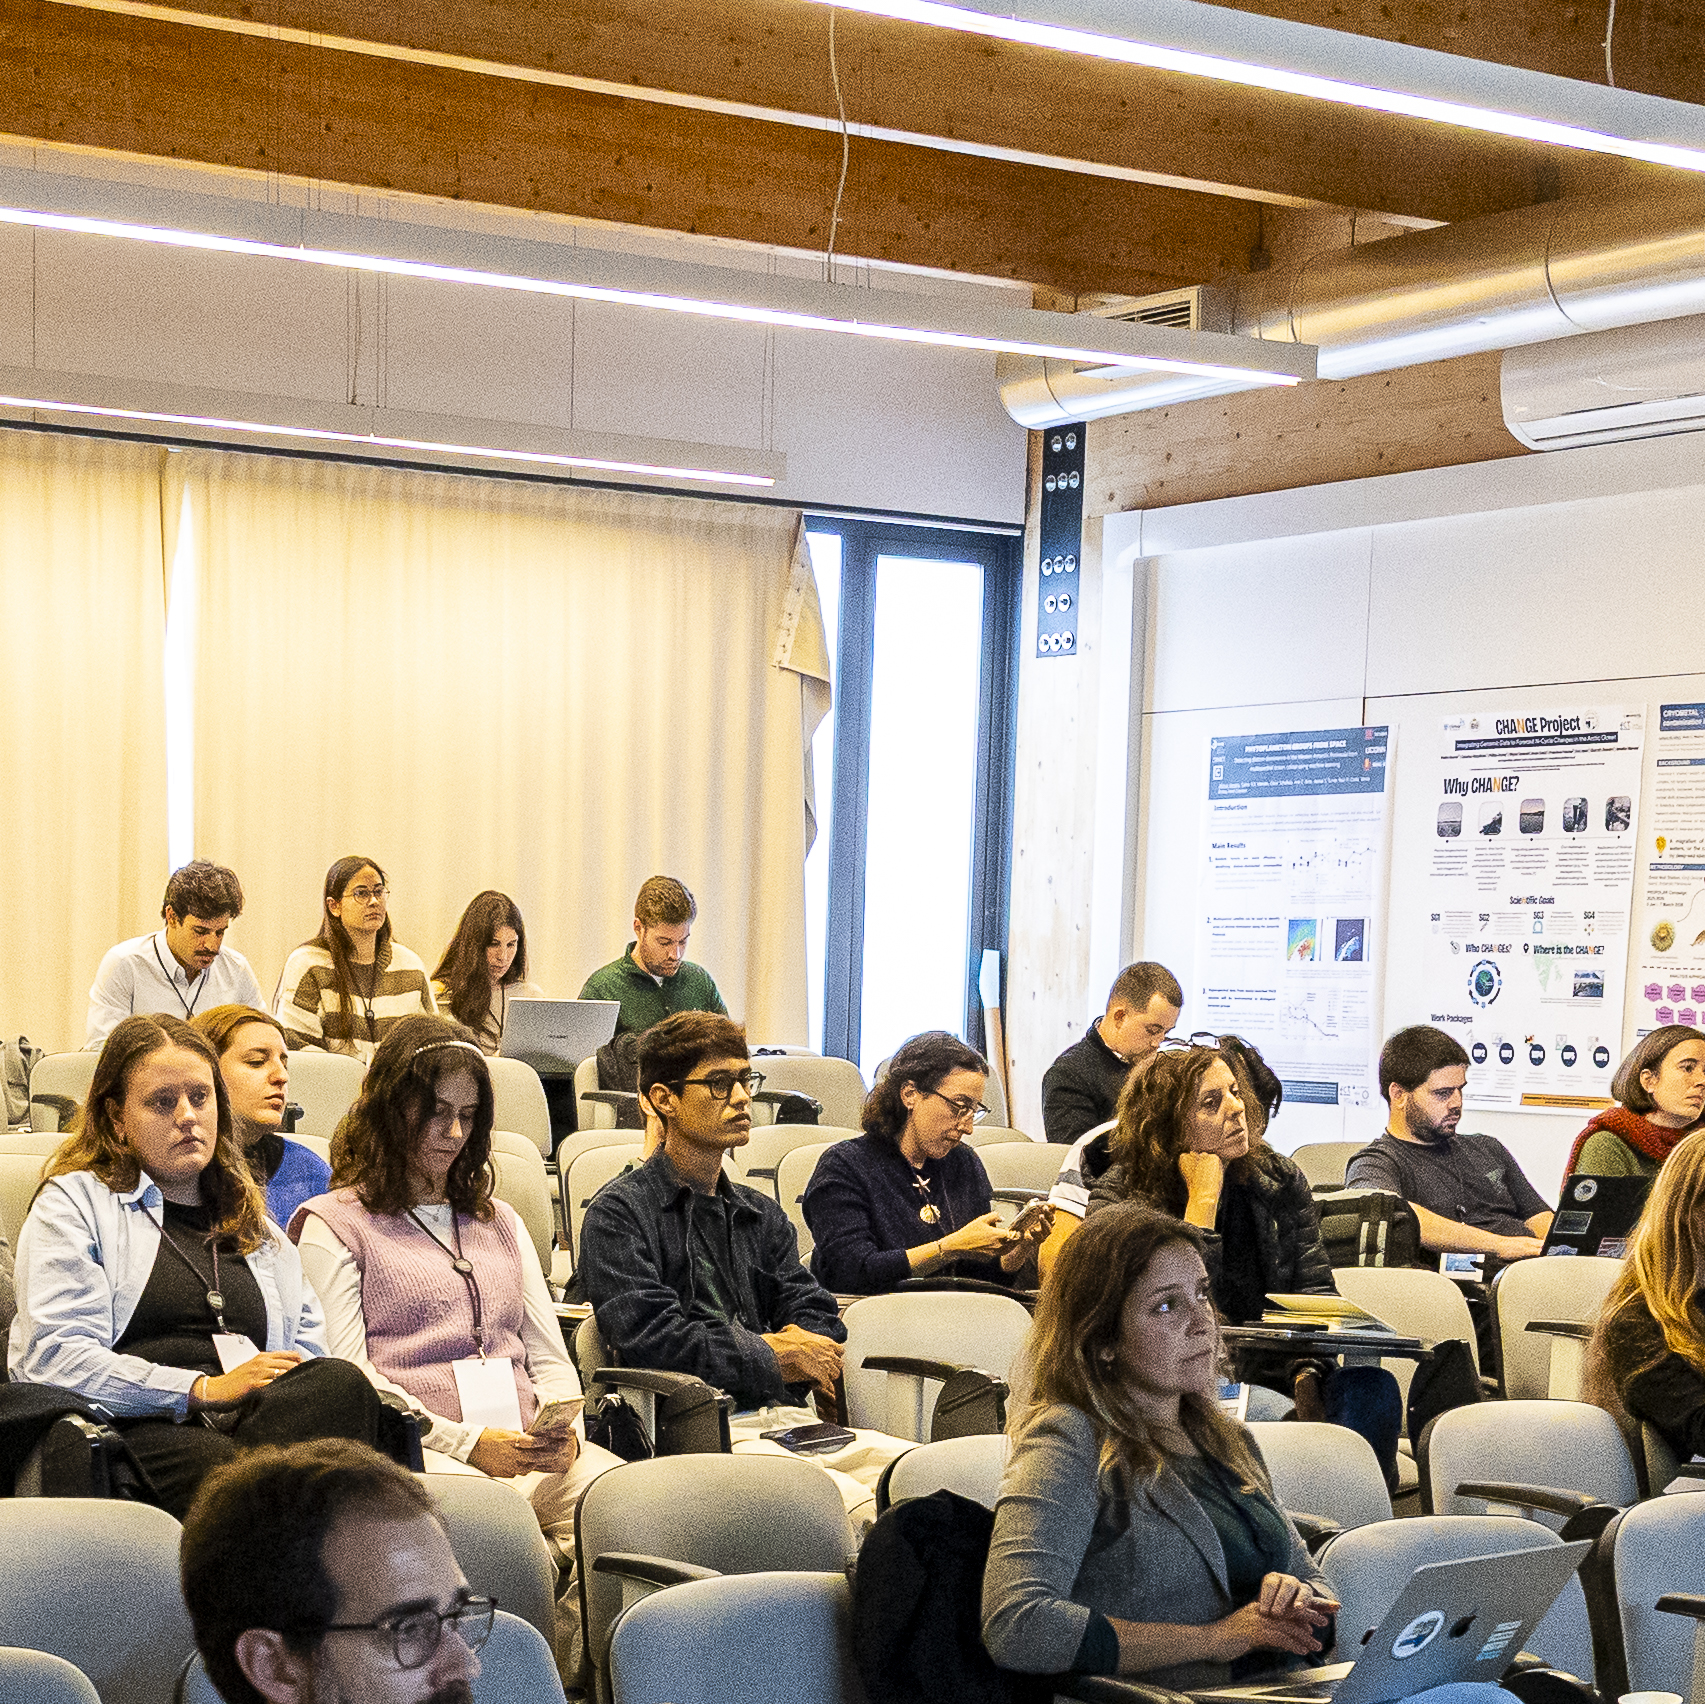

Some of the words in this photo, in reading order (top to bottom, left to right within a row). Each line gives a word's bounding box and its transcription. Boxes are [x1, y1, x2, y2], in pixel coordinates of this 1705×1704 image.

[1496, 718, 1538, 735] CHANGE
[1540, 715, 1581, 735] Project
[1329, 740, 1346, 748] SPACE
[1444, 778, 1469, 796] Why
[1471, 776, 1519, 793] CHANGE?
[1466, 944, 1480, 953] Who
[1533, 945, 1554, 954] Where
[1556, 945, 1562, 954] is
[1564, 945, 1574, 954] the
[1576, 946, 1604, 954] CHANGE?
[1430, 1014, 1445, 1022] Work
[1446, 1014, 1473, 1024] Packages
